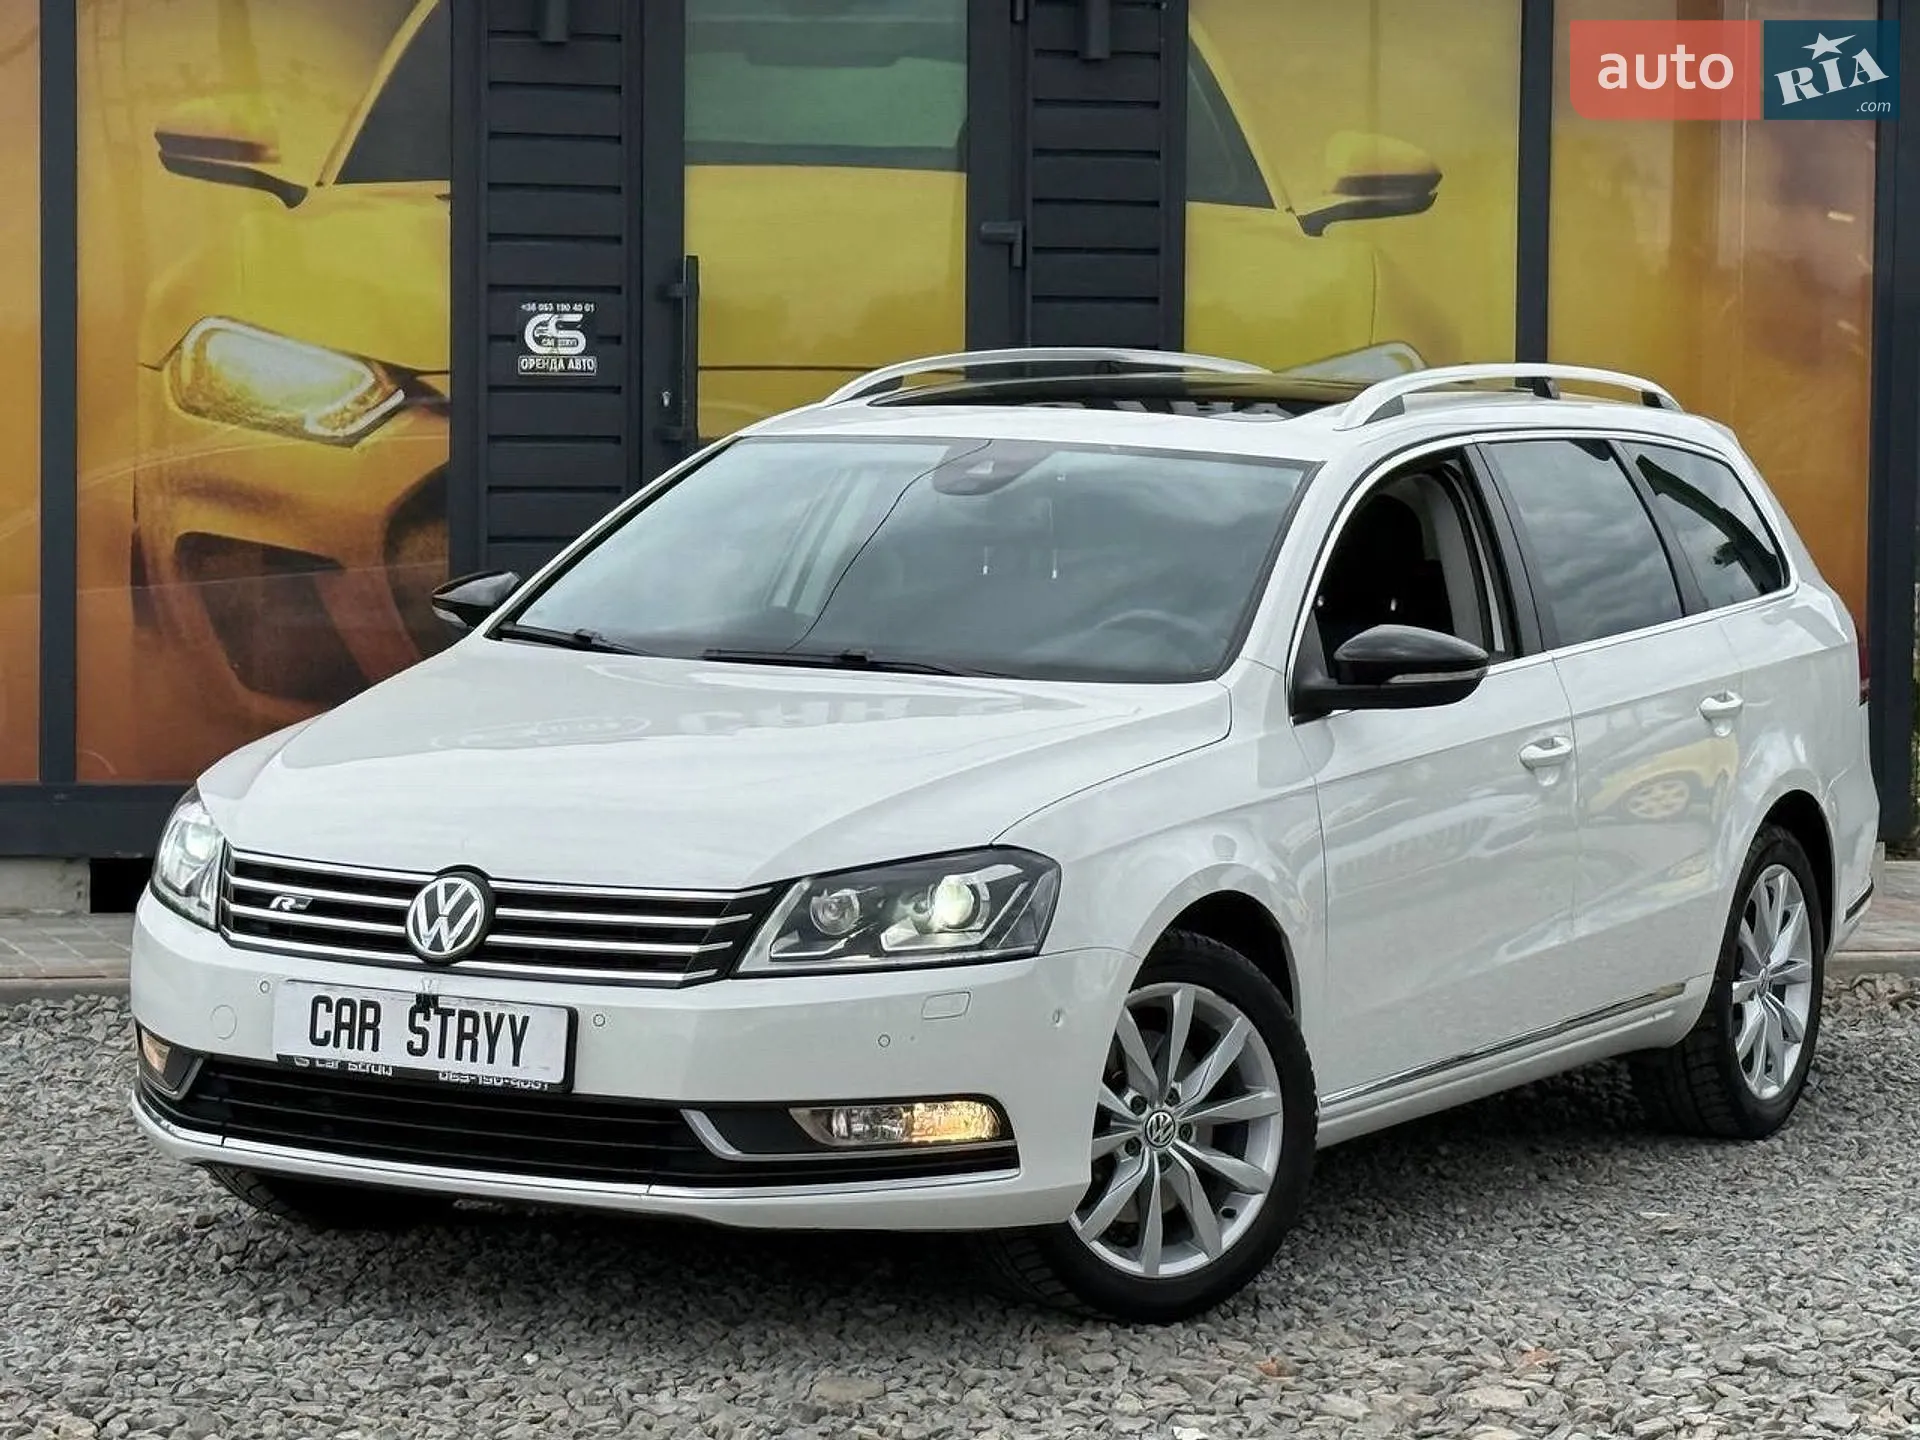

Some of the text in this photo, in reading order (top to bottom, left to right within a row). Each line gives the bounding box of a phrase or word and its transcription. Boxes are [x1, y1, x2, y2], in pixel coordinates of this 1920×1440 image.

[520, 359, 595, 372] ОРЕНДА АВТО
[309, 995, 530, 1067] CAR STRYY
